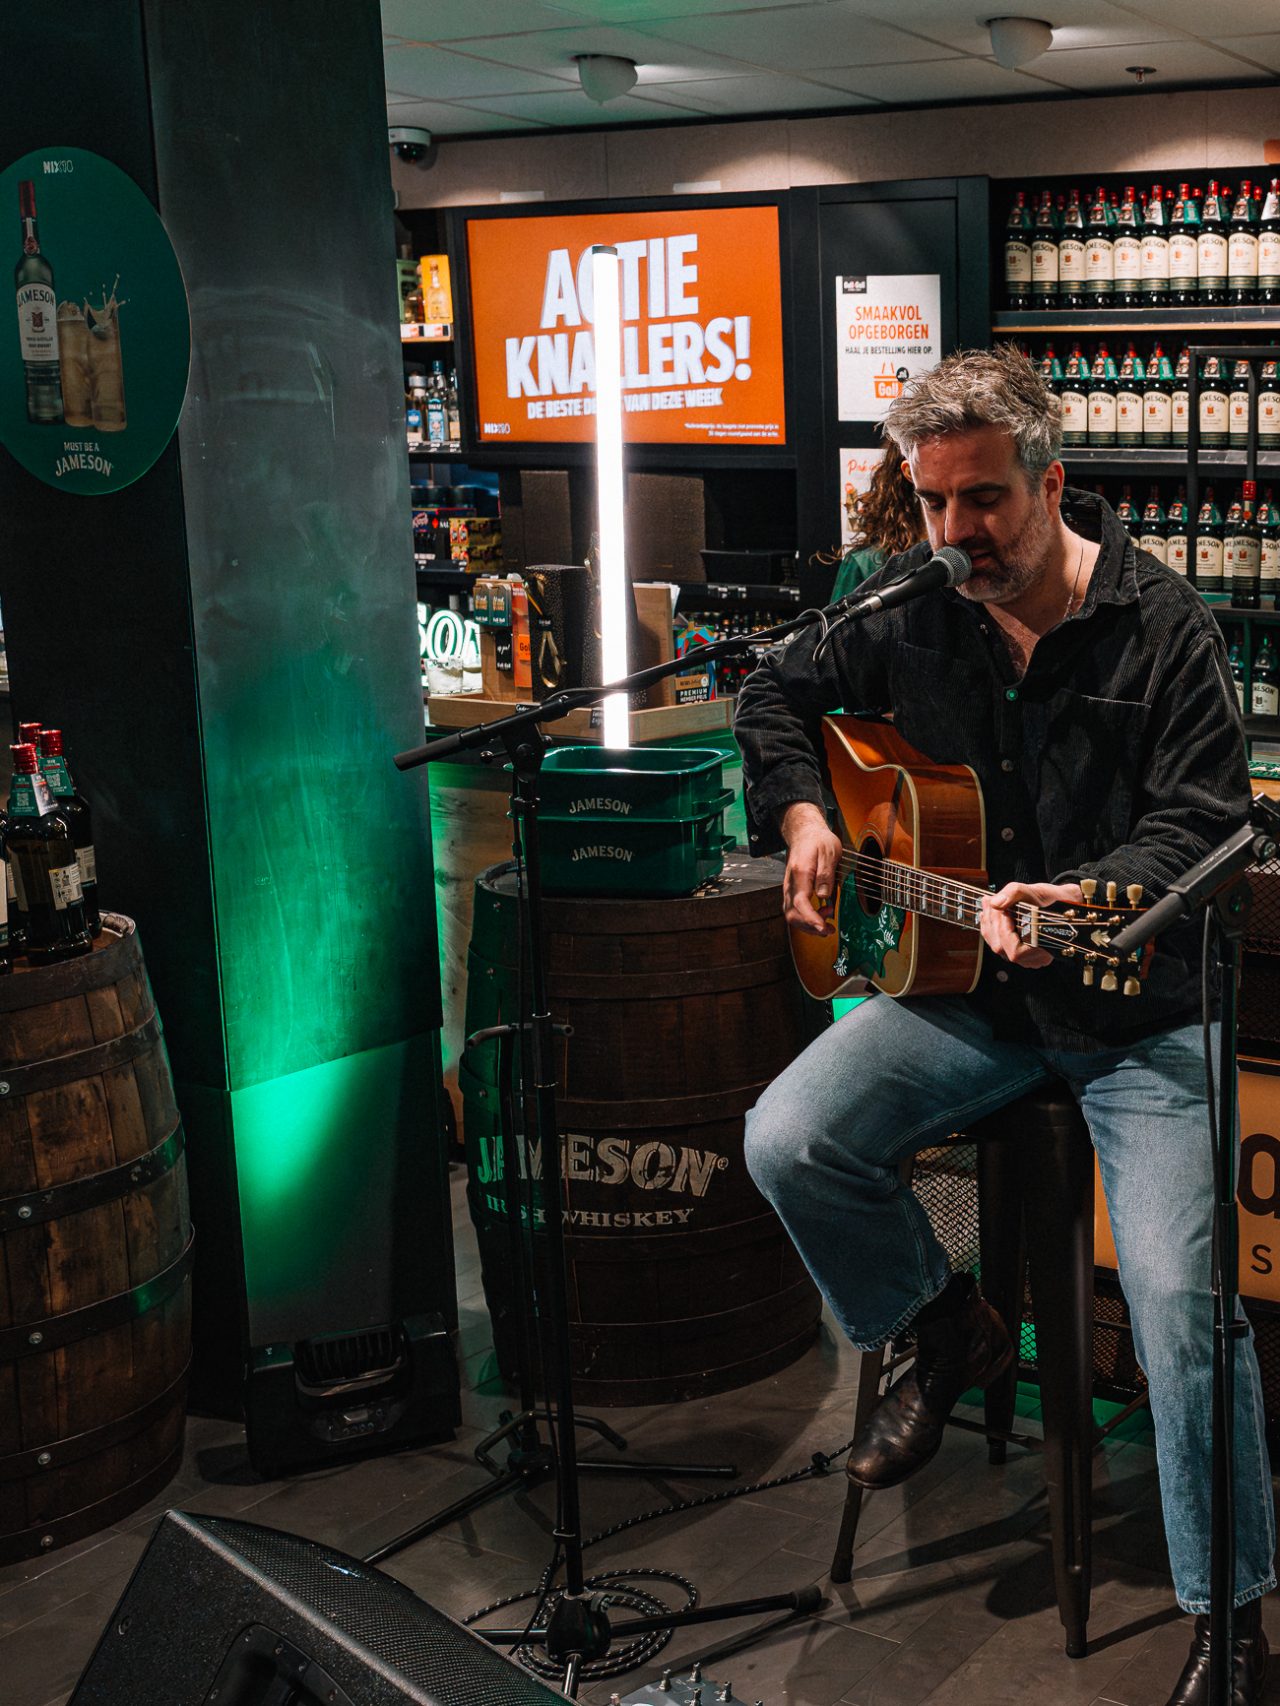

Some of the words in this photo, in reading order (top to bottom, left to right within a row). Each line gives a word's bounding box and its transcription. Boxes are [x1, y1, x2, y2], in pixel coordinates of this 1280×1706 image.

[856, 305, 922, 321] SMAAKVOL
[848, 324, 929, 339] OPGEBORGEN
[506, 316, 752, 399] KNALERS!
[845, 346, 861, 355] HAAL
[862, 346, 869, 354] JE
[871, 346, 906, 354] BESTELLING
[907, 346, 921, 354] HIER
[528, 402, 545, 419] DE
[545, 400, 584, 418] BESTE
[624, 393, 651, 413] VAN
[652, 390, 685, 411] DEZE
[686, 389, 721, 408] WEEK
[56, 454, 113, 477] JAMESON
[1233, 537, 1260, 548] AMESON
[680, 687, 708, 697] PREMIUM
[569, 797, 630, 815] JAMESON
[572, 845, 632, 863] JAMESON
[486, 1195, 546, 1224] IRSH
